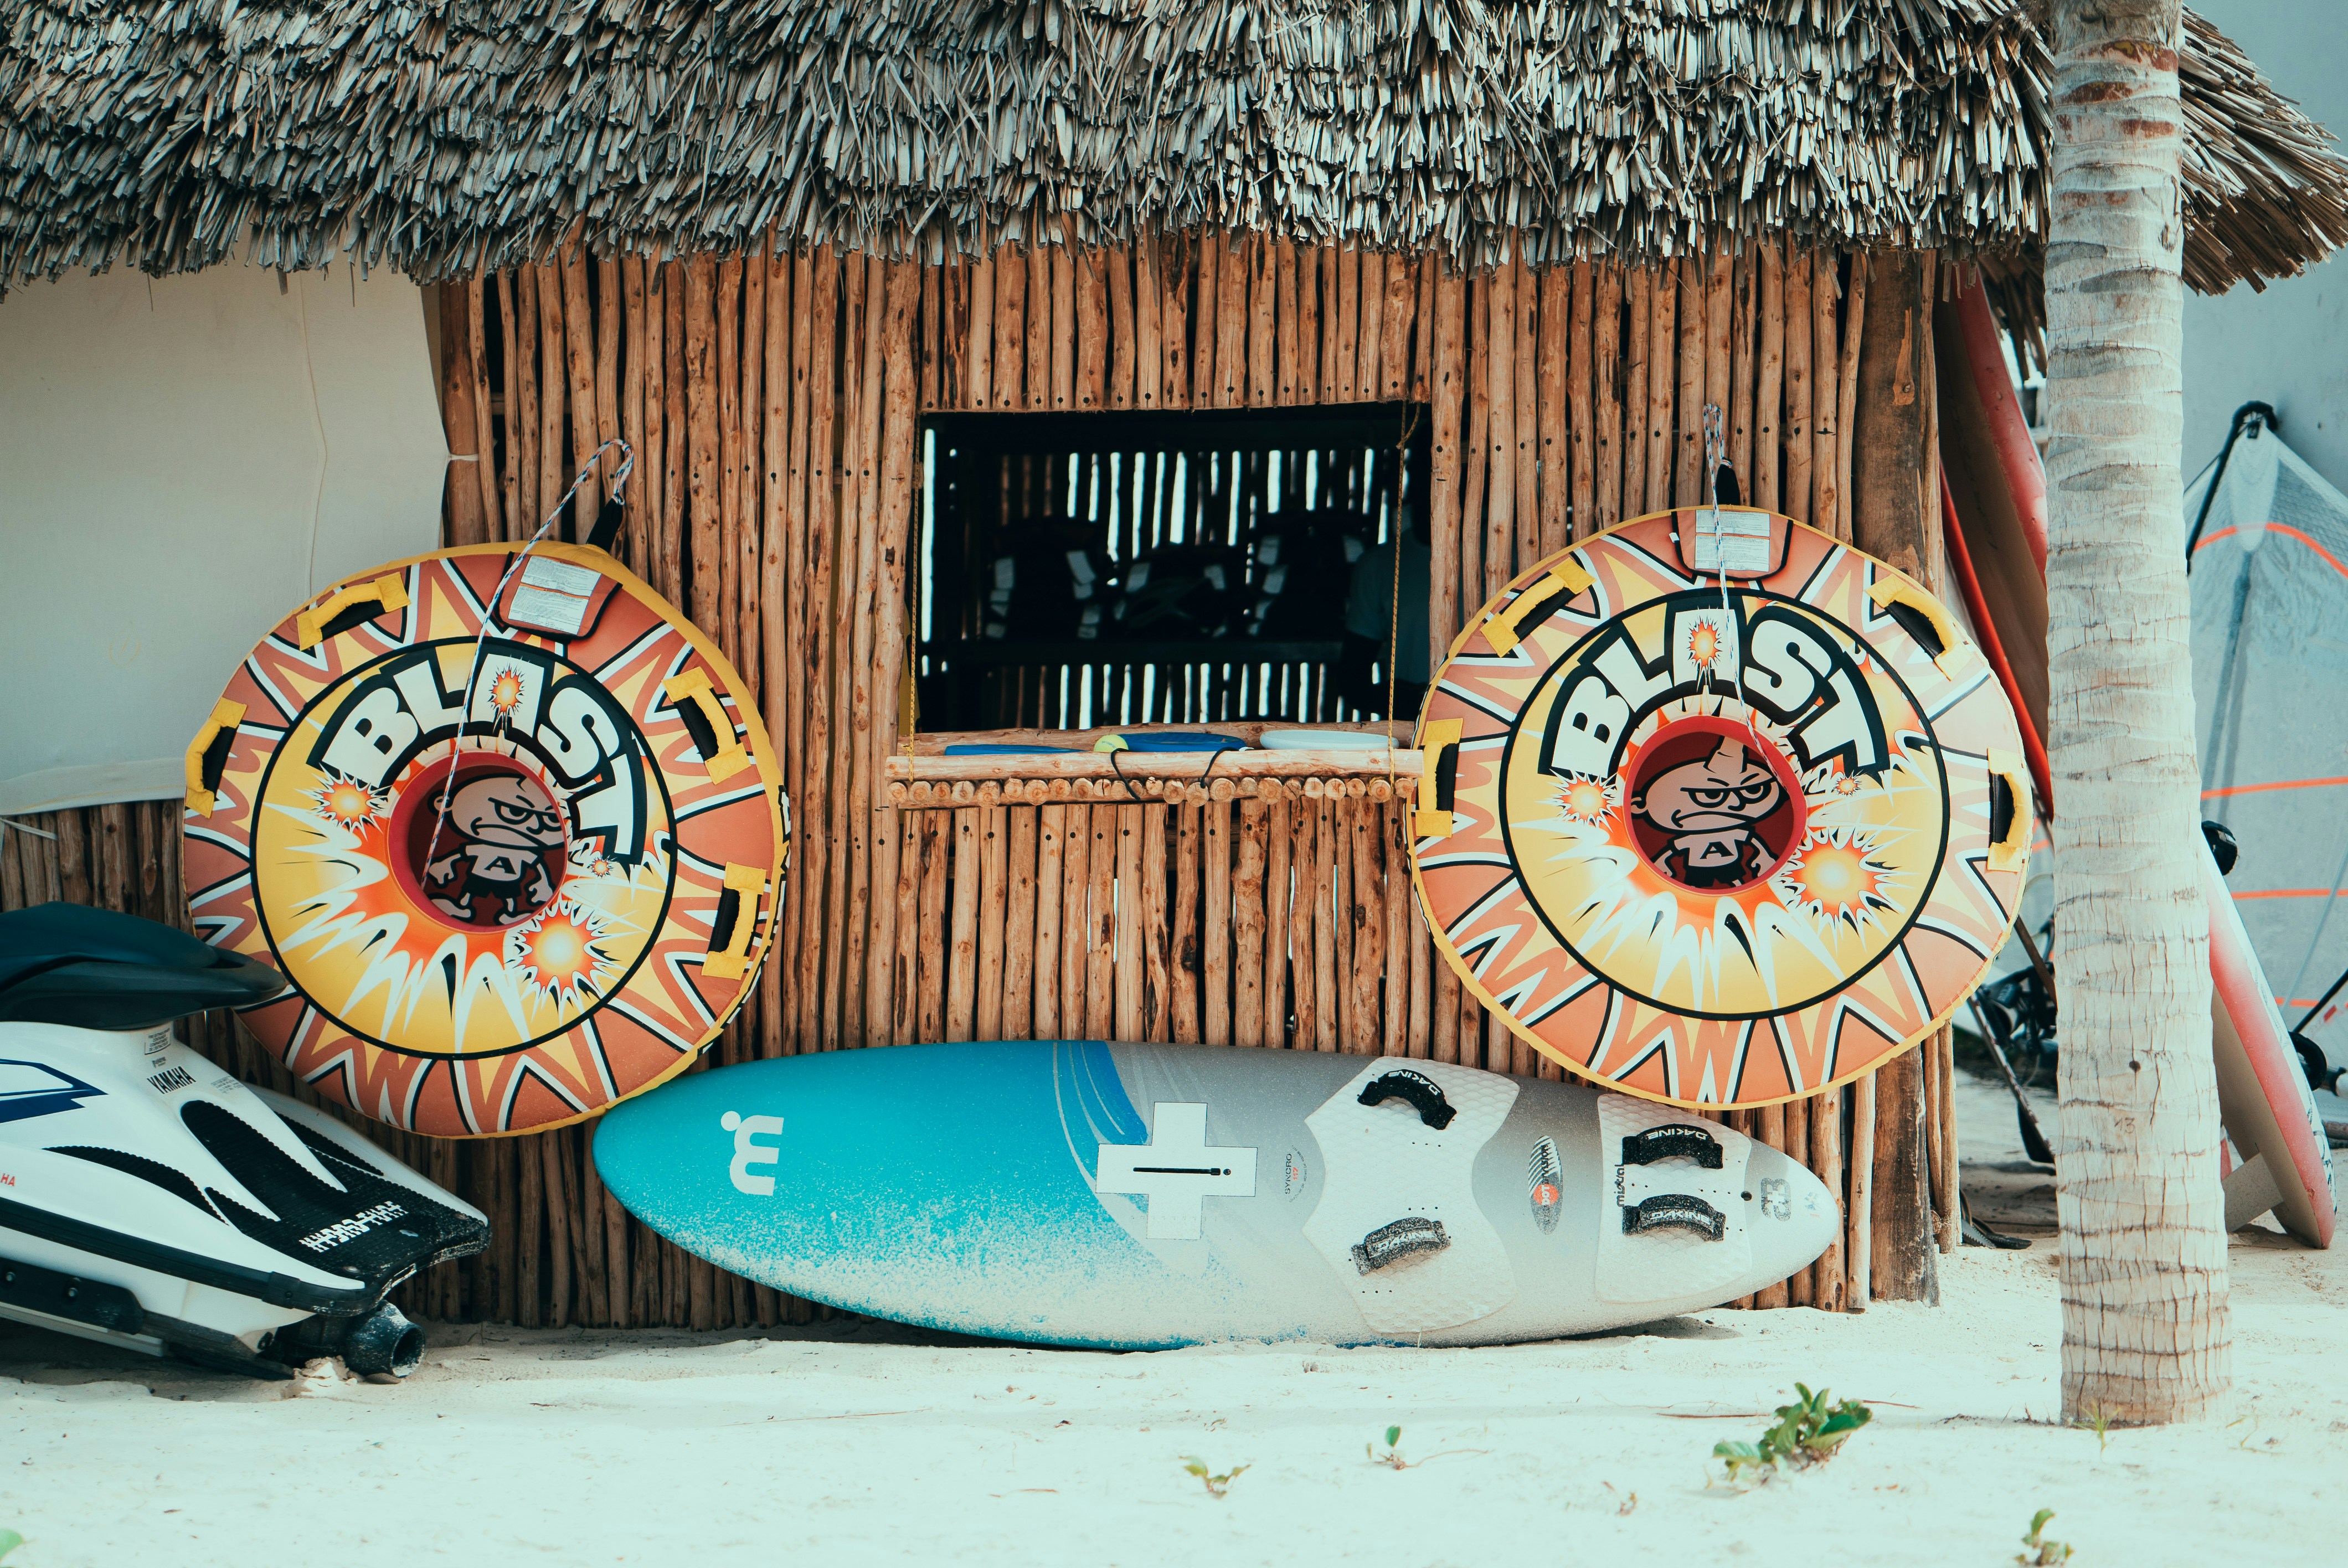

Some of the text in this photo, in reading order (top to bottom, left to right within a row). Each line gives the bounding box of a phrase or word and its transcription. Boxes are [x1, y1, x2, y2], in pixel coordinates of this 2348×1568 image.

[1549, 606, 1877, 779] BLAST
[320, 651, 635, 856] BLAST
[1700, 841, 1734, 859] A
[484, 855, 517, 875] A
[147, 1066, 197, 1094] YAMAHA
[1388, 1070, 1441, 1096] DAKINE
[1645, 1128, 1708, 1141] DAKINE
[2114, 1117, 2135, 1133] 13
[1541, 1184, 1551, 1206] DOT
[1614, 1164, 1625, 1207] mistral
[1650, 1209, 1711, 1226] DAKINE
[1377, 1230, 1435, 1251] DAKINE
